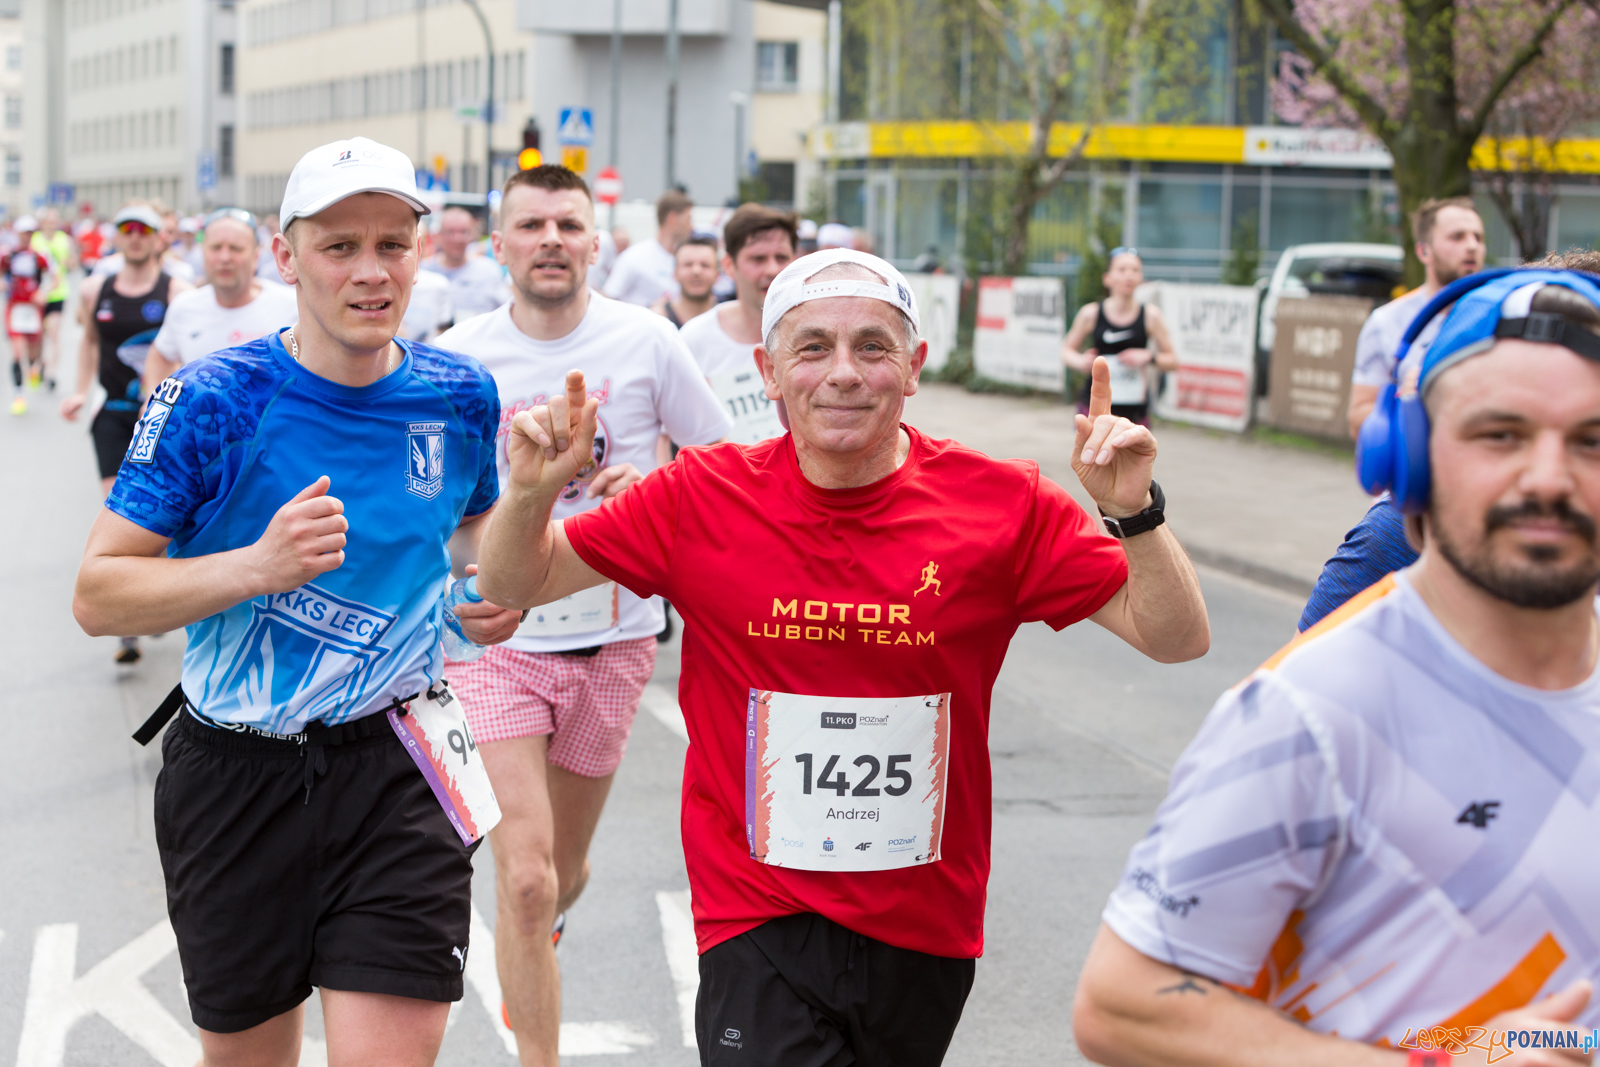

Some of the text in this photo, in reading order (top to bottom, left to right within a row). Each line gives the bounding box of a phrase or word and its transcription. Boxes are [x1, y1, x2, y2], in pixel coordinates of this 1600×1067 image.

[425, 423, 442, 431] LECH
[276, 590, 328, 622] KKS
[771, 598, 912, 625] MOTOR
[748, 620, 936, 646] LUBOŃ TEAM
[794, 752, 913, 797] 1425
[825, 807, 881, 823] Andrzej
